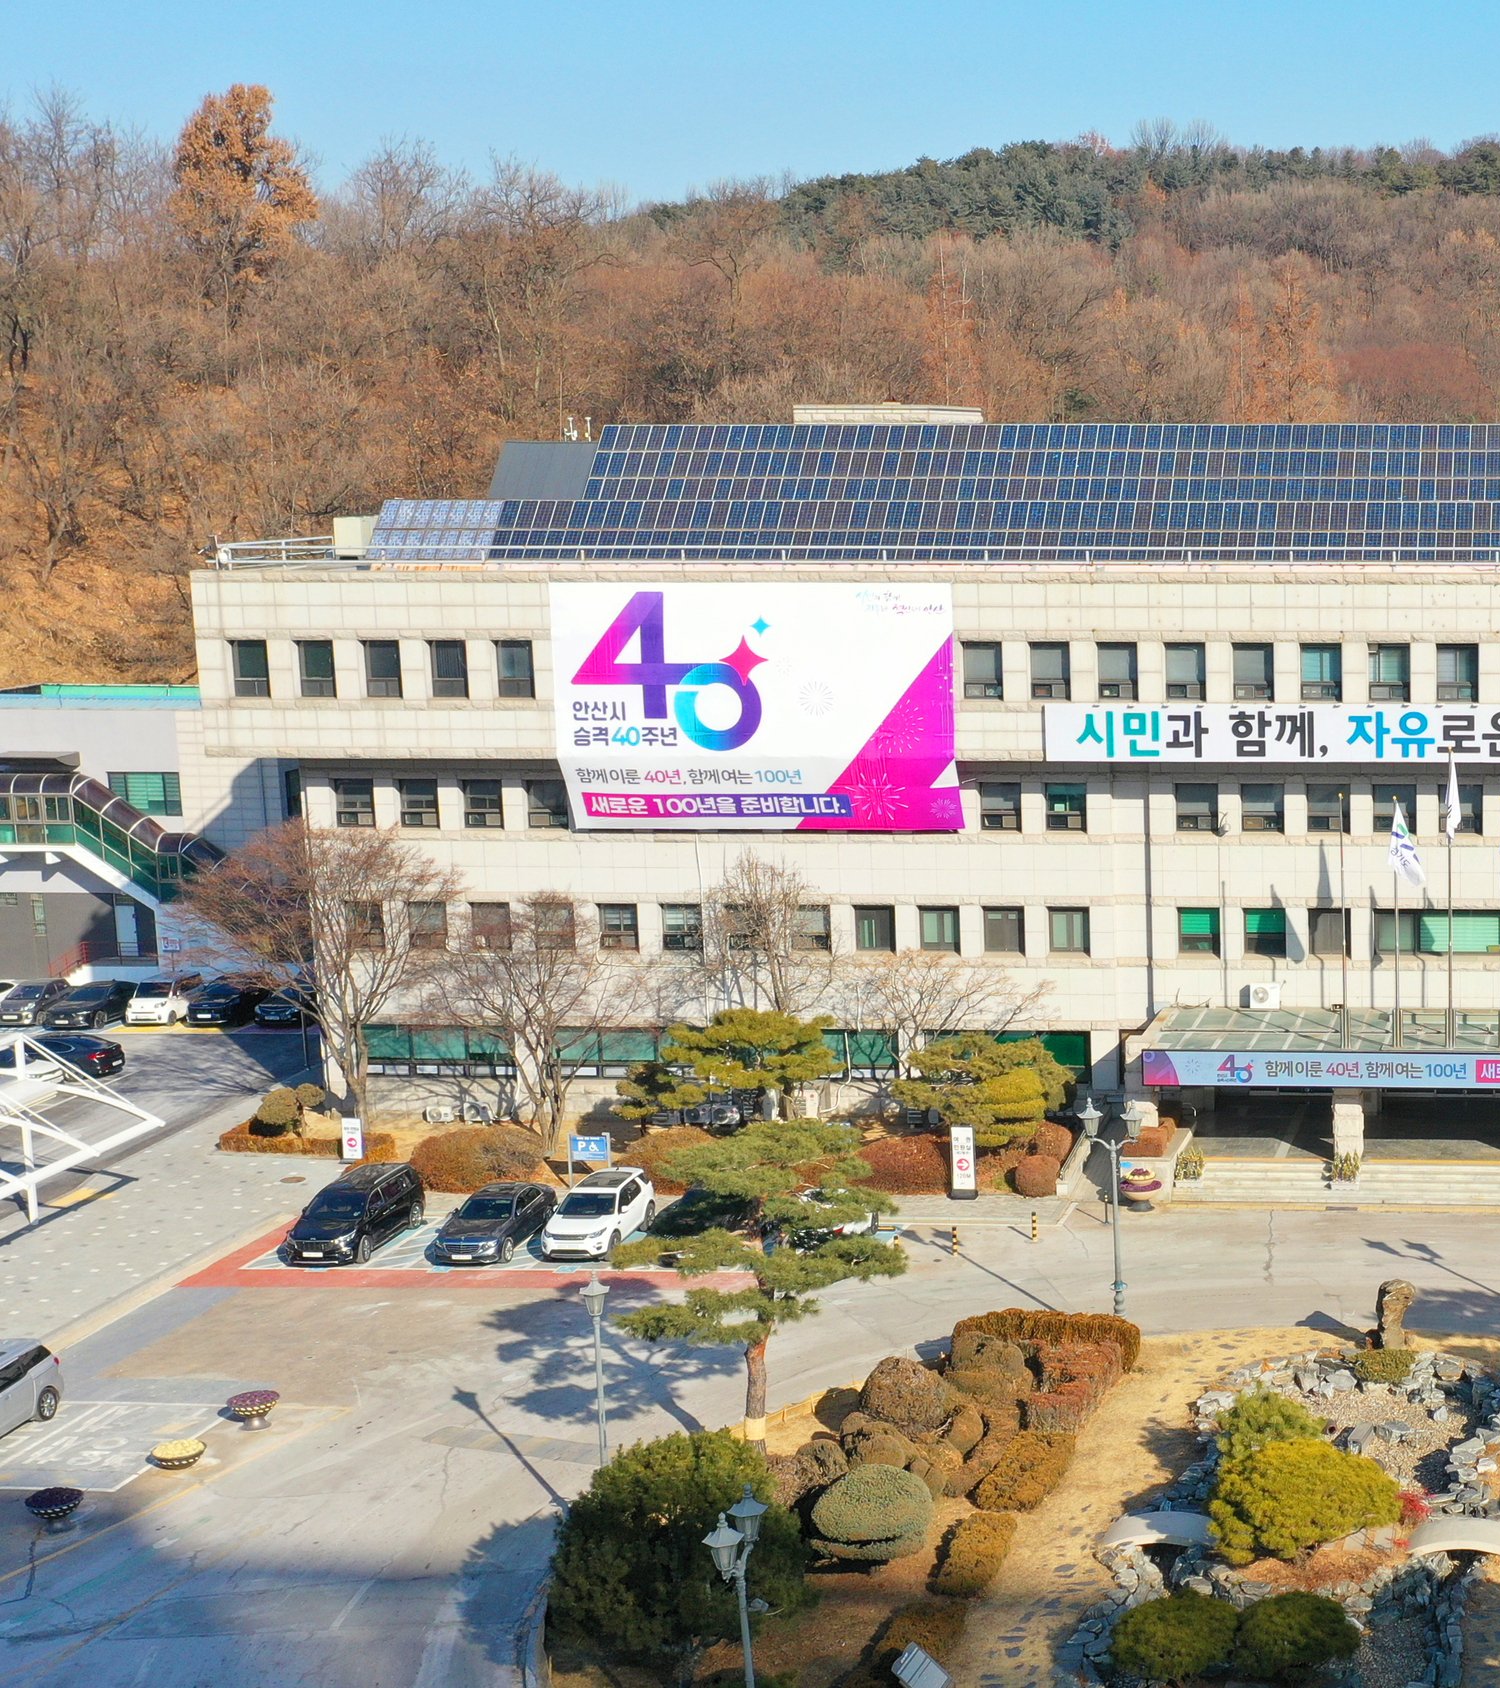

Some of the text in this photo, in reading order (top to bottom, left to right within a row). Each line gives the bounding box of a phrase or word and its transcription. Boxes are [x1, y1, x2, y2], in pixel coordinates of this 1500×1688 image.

[572, 701, 626, 721] 안산시
[573, 726, 678, 746] 승격40주년
[1076, 711, 1209, 758] 시민과
[1229, 711, 1328, 758] 함께,
[644, 769, 687, 785] 40년,
[754, 769, 803, 785] 100년
[591, 796, 847, 815] 새로운 100년을 준비합니다.
[1326, 1061, 1363, 1079] 40년,
[1425, 1062, 1467, 1080] 100년
